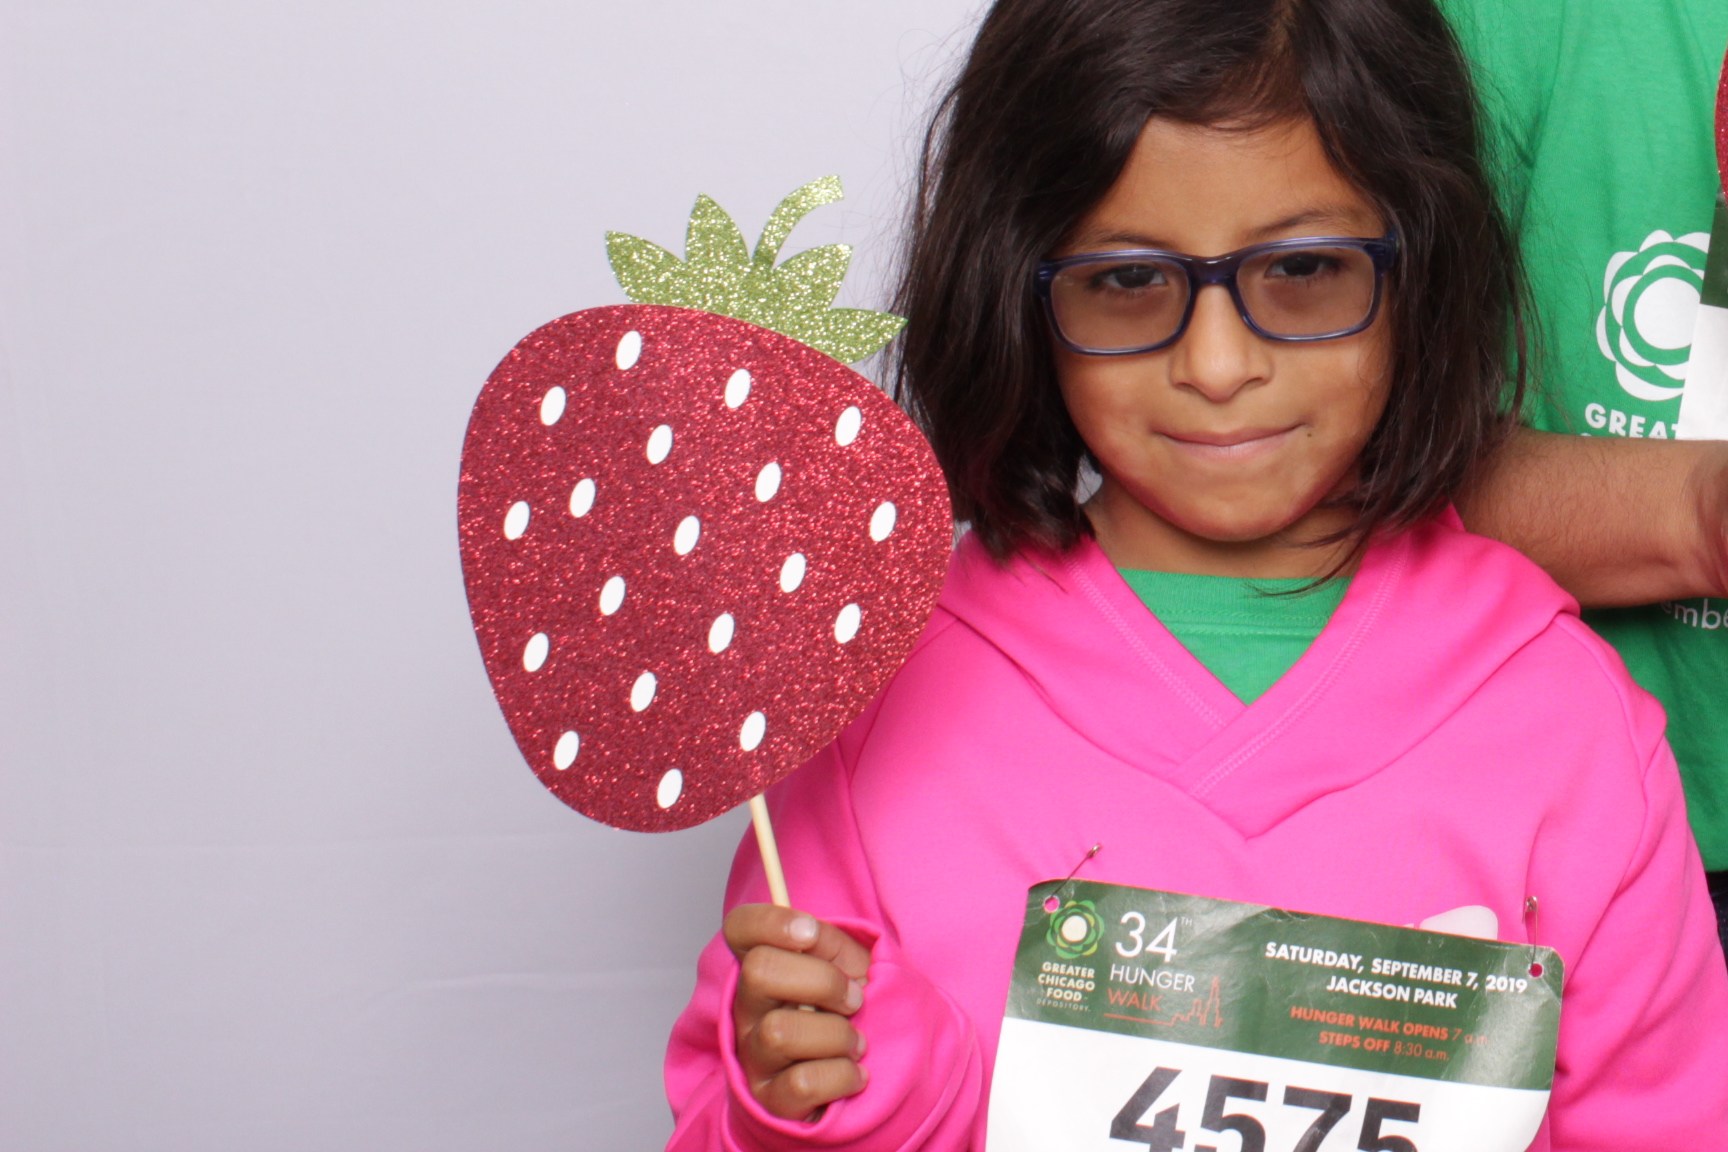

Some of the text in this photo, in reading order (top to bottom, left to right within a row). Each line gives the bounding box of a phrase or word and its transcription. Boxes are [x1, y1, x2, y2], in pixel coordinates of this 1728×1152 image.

[1037, 973, 1095, 992] CHICAGO
[1042, 961, 1095, 979] GREATER
[1110, 963, 1195, 993] HUNGER
[1265, 941, 1528, 994] SATURDAY, SEPTEMBER 7, 2019
[1107, 988, 1163, 1012] WALK
[1326, 976, 1458, 1009] JACKSON PARK
[1290, 1006, 1355, 1027] HUNGER
[1358, 1016, 1400, 1034] WALK
[1403, 1023, 1449, 1041] OPENS
[1452, 1028, 1462, 1041] 7
[1319, 1031, 1450, 1062] STEPS OFF 8:30 a.m.
[1109, 1066, 1421, 1152] 4575
